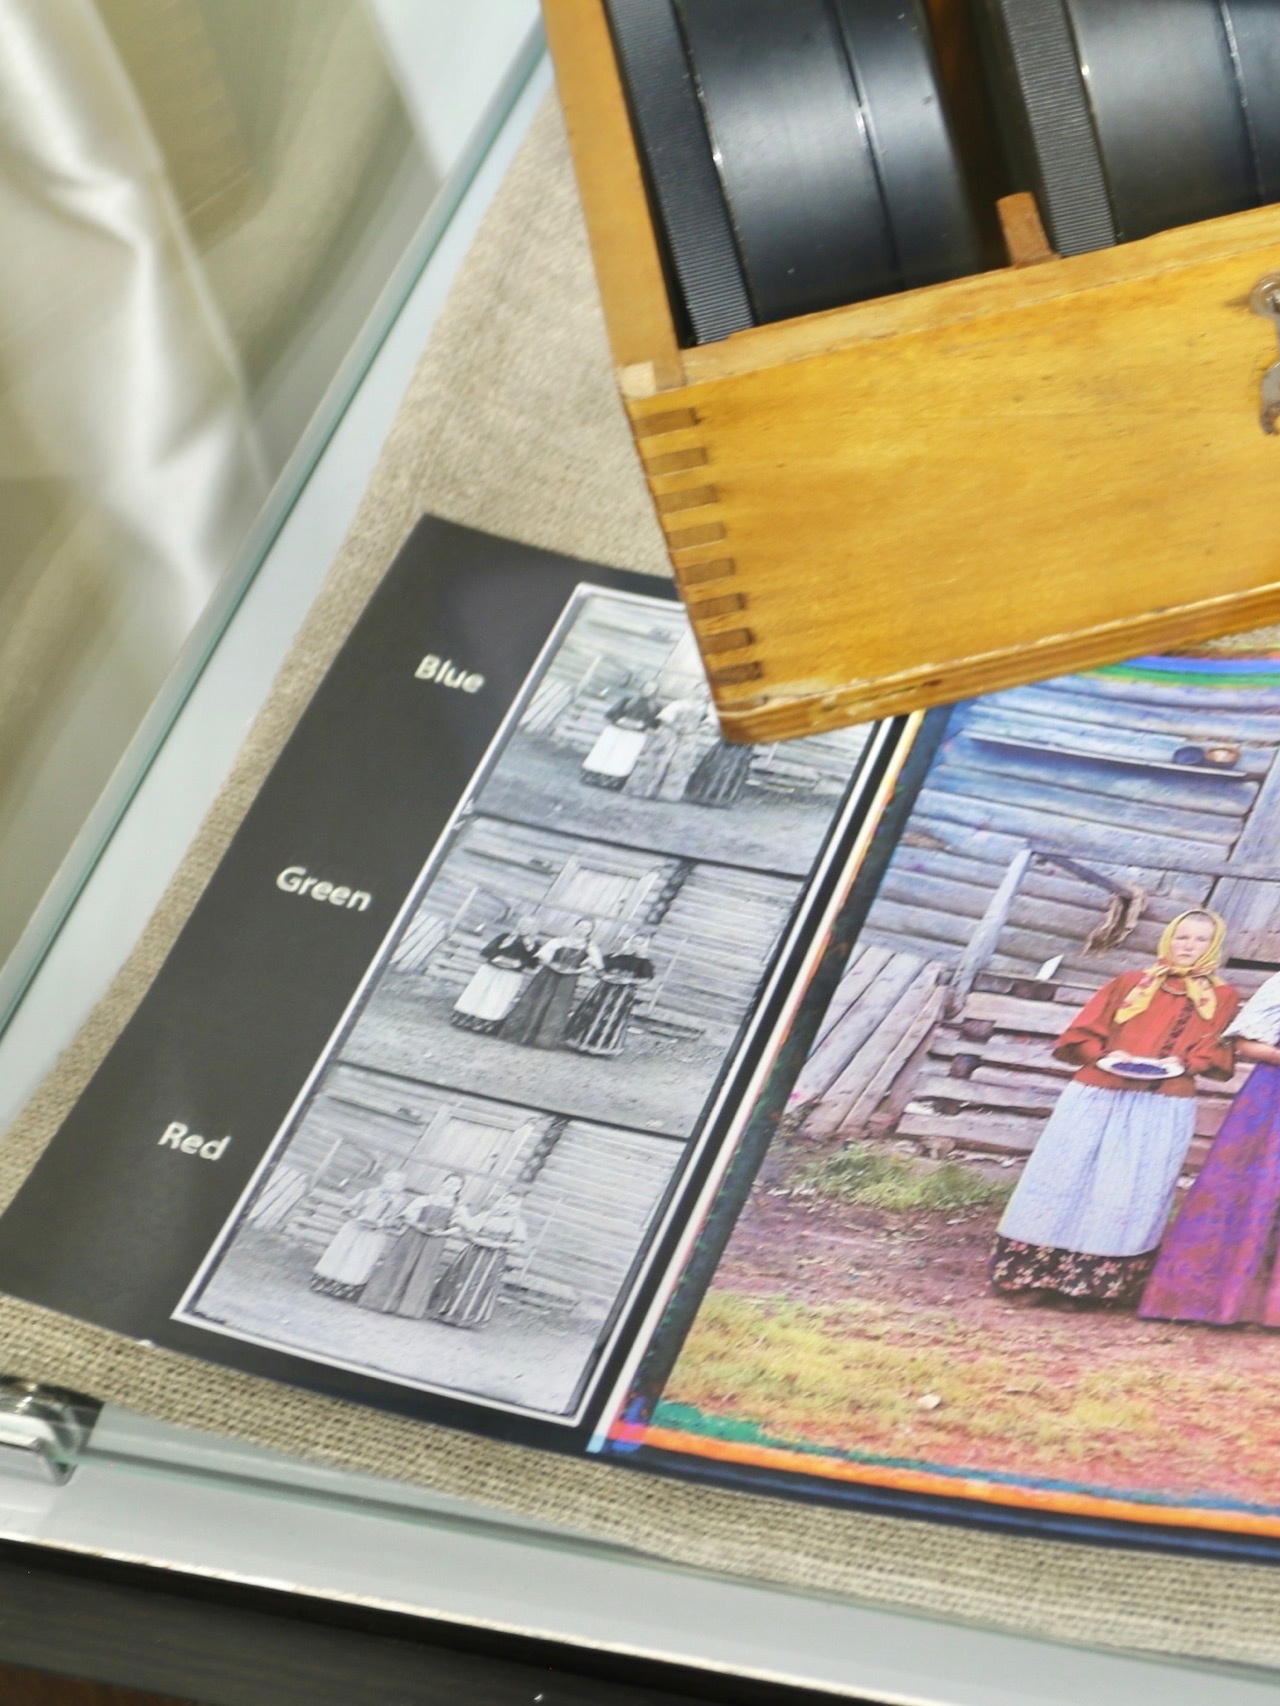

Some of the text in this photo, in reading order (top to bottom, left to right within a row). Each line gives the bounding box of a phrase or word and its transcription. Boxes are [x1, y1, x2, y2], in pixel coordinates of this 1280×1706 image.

[415, 654, 485, 694] Blue
[276, 866, 373, 913] Green
[158, 1121, 232, 1162] Red
